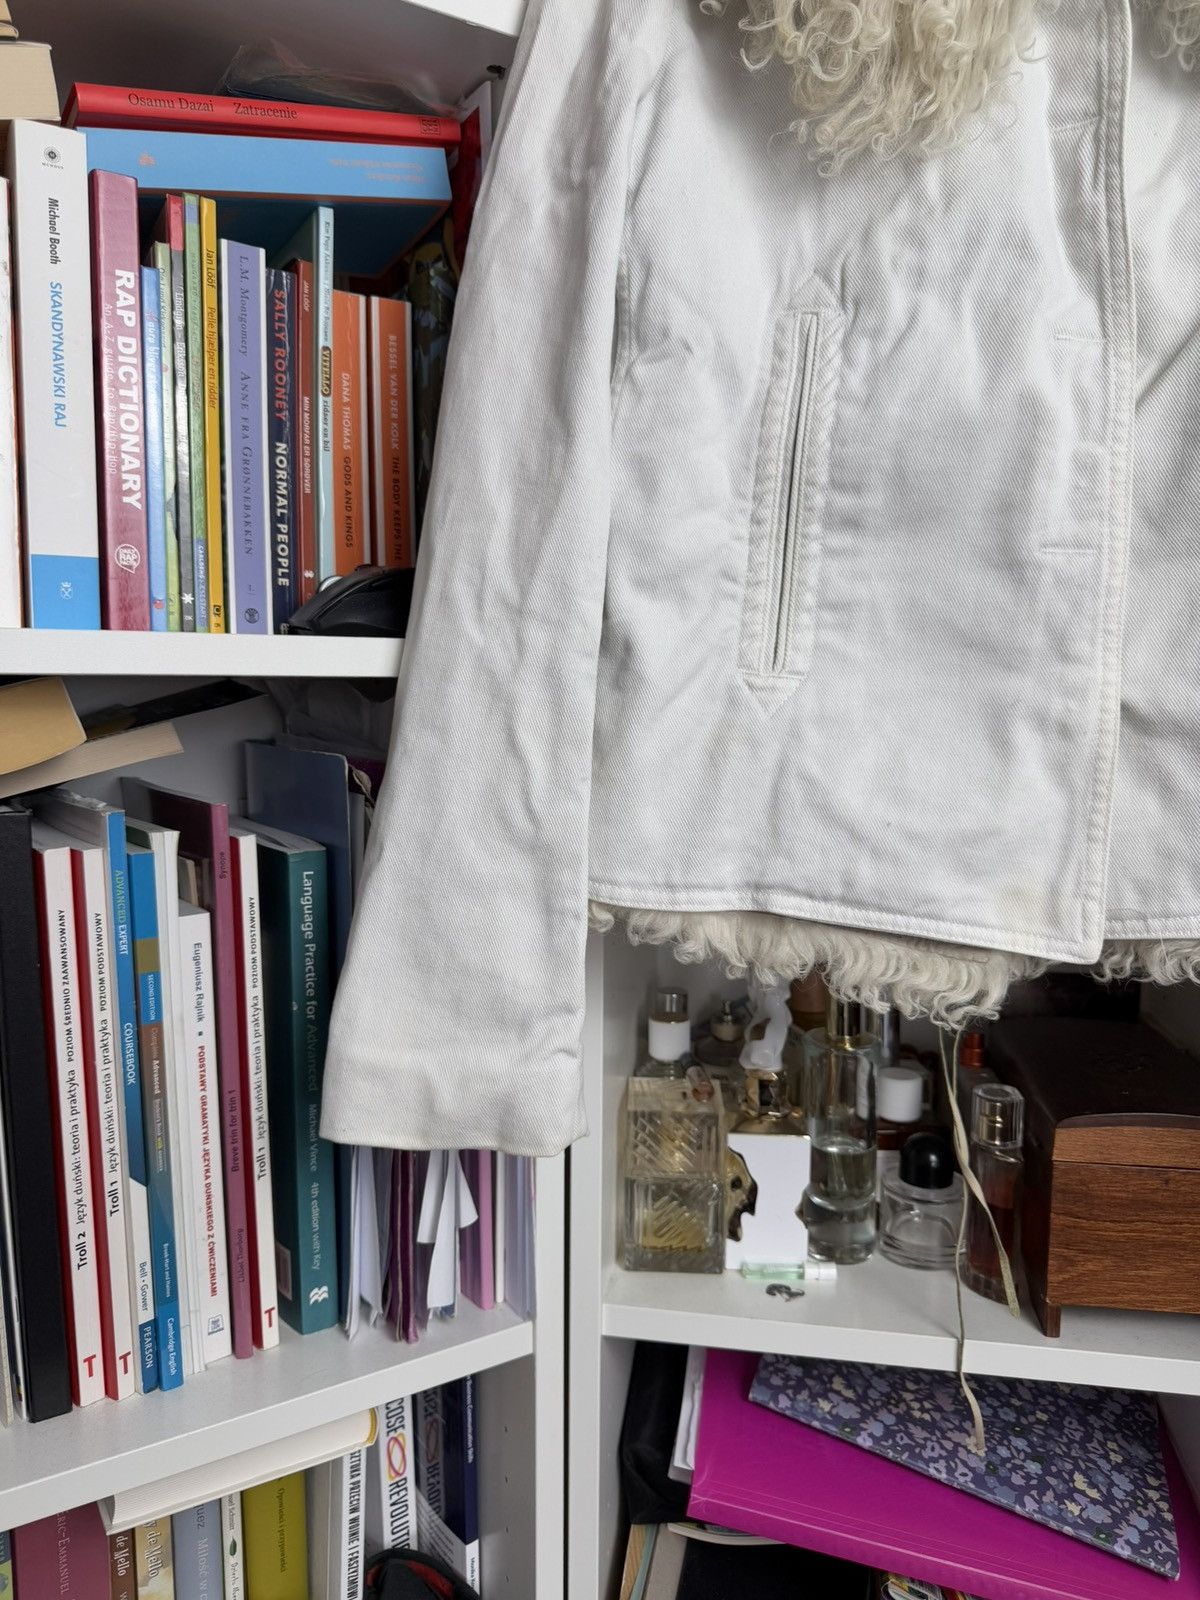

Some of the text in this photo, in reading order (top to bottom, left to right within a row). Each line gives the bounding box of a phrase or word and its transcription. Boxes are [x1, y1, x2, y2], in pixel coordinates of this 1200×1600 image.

[128, 91, 215, 114] Osamu Dazai
[233, 102, 298, 120] Zatracenie
[48, 197, 61, 265] Michael Booth
[206, 248, 216, 289] Jan Lööf
[104, 322, 113, 342] A-Z
[238, 287, 250, 357] Montgomery
[50, 281, 67, 428] SKANDYNAWSKI RAJ
[205, 306, 218, 409] Pelle hjælper en ridder
[274, 289, 288, 422] SALLY ROONEY
[320, 349, 331, 395] VITELLO
[115, 269, 143, 511] RAP DICTIONARY
[303, 396, 311, 411] MIN
[341, 372, 352, 450] DANA THOMAS
[388, 335, 400, 450] BESSEL VAN DER KOLK
[303, 412, 311, 445] MORFAR
[303, 445, 311, 456] ER
[275, 442, 290, 587] NORMAL PEOPLE
[343, 456, 354, 549] GODS AND KINGS
[392, 456, 402, 561] THE BODY KEEPS THE
[217, 851, 227, 879] Synope
[115, 870, 128, 956] ADVANCED EXPERT
[93, 912, 107, 1012] POZIOM PODSTAWOWY
[248, 896, 259, 989] POZIOM PODSTAWOWY
[57, 909, 75, 1062] POZIOM ŚREDNIO ZAAWANSOWANY
[147, 973, 156, 1021] SECOND EDITION
[191, 942, 206, 1023] Eugeniusz Rajnik
[300, 871, 318, 1092] Language Practice for Advanced
[251, 995, 262, 1038] praktyka
[99, 1019, 112, 1065] praktyka
[123, 1022, 137, 1085] COURSEBOOK
[253, 1046, 263, 1076] teoria
[102, 1072, 114, 1105] teoria
[152, 1059, 161, 1095] Advanced
[196, 1045, 207, 1093] PODSTAWY
[66, 1070, 79, 1116] praktyka
[229, 1096, 237, 1110] trin
[70, 1124, 81, 1156] teoria
[104, 1107, 117, 1145] duński:
[200, 1094, 210, 1146] GRAMATYKI
[229, 1111, 238, 1128] for
[230, 1129, 239, 1145] trin
[254, 1113, 267, 1141] Język
[307, 1103, 319, 1172] Michael Vince
[71, 1157, 85, 1196] duński:
[106, 1145, 118, 1174] Język
[201, 1147, 212, 1181] JĘZYKA
[230, 1145, 240, 1173] Breve
[256, 1153, 267, 1181] Troll
[74, 1197, 87, 1225] Język
[108, 1188, 120, 1217] Troll
[205, 1182, 215, 1232] DUŃSKIEGO
[310, 1182, 322, 1270] 4th edition with Key
[74, 1230, 89, 1270] Troll 2
[207, 1241, 218, 1297] ĆWICZENIAMI
[139, 1261, 149, 1312] Bell Gower
[144, 1326, 154, 1369] PEARSON
[166, 1317, 178, 1376] Cambridge English
[348, 1481, 361, 1515] PRZECIW
[115, 1535, 129, 1548] de
[146, 1531, 162, 1544] de
[347, 1515, 361, 1546] WOJNIE
[113, 1548, 130, 1577] Mello
[144, 1544, 163, 1578] Mello
